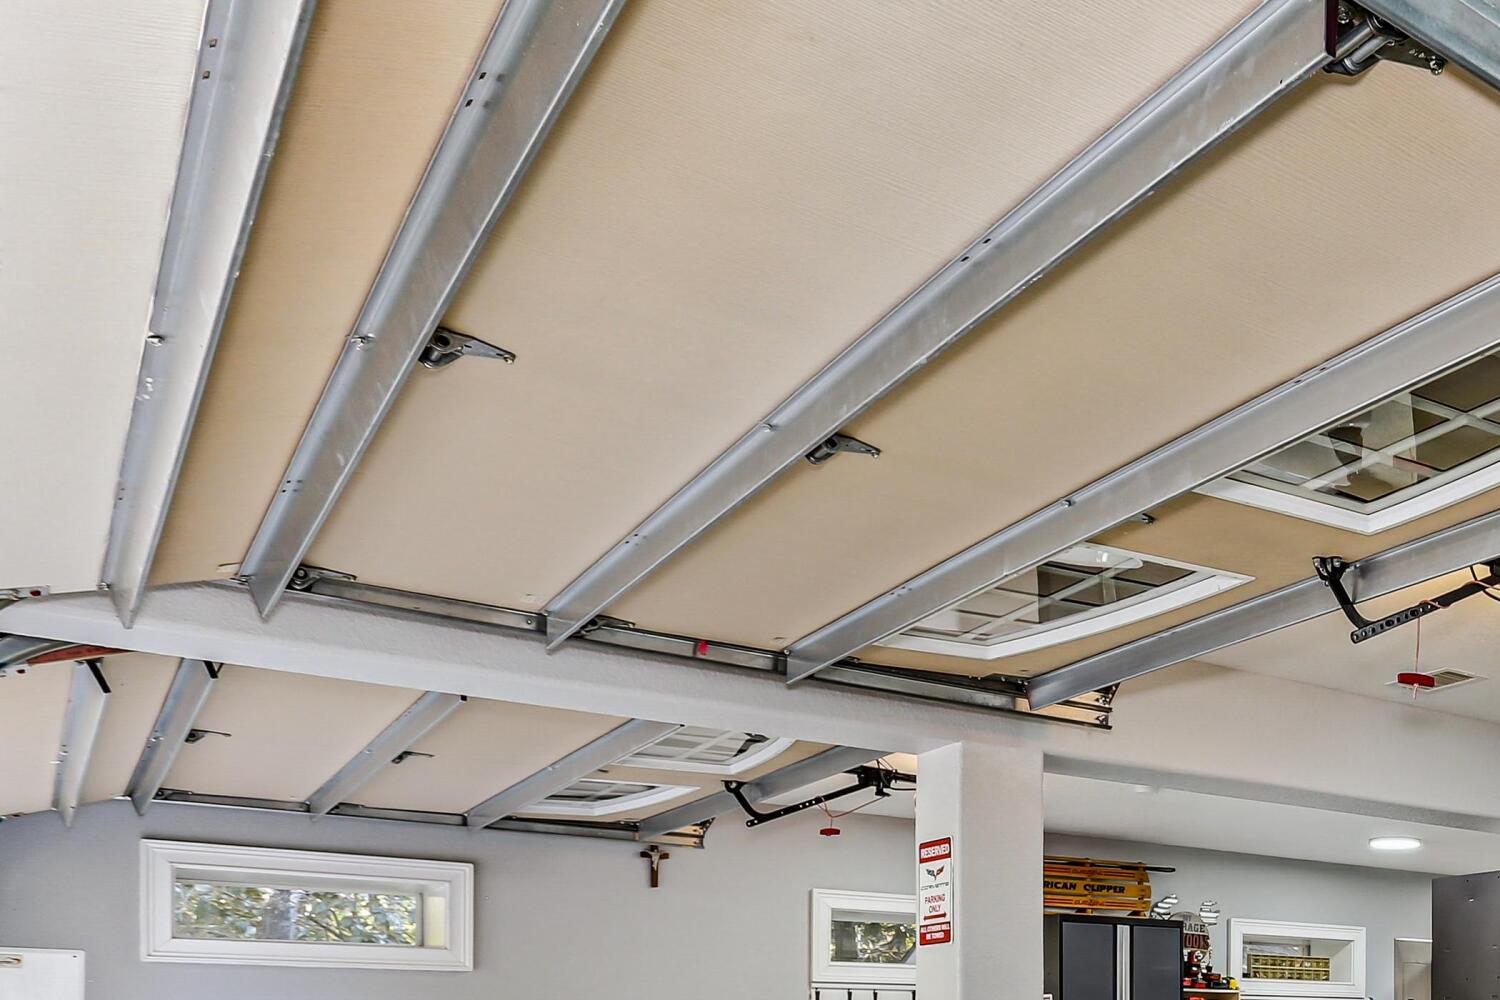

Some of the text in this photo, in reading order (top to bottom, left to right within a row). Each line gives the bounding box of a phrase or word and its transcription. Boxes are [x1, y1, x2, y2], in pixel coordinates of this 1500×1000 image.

[920, 843, 950, 859] RESERVED
[1083, 883, 1125, 894] CLIPPER
[924, 893, 945, 904] PARKING
[928, 904, 941, 913] ONLY
